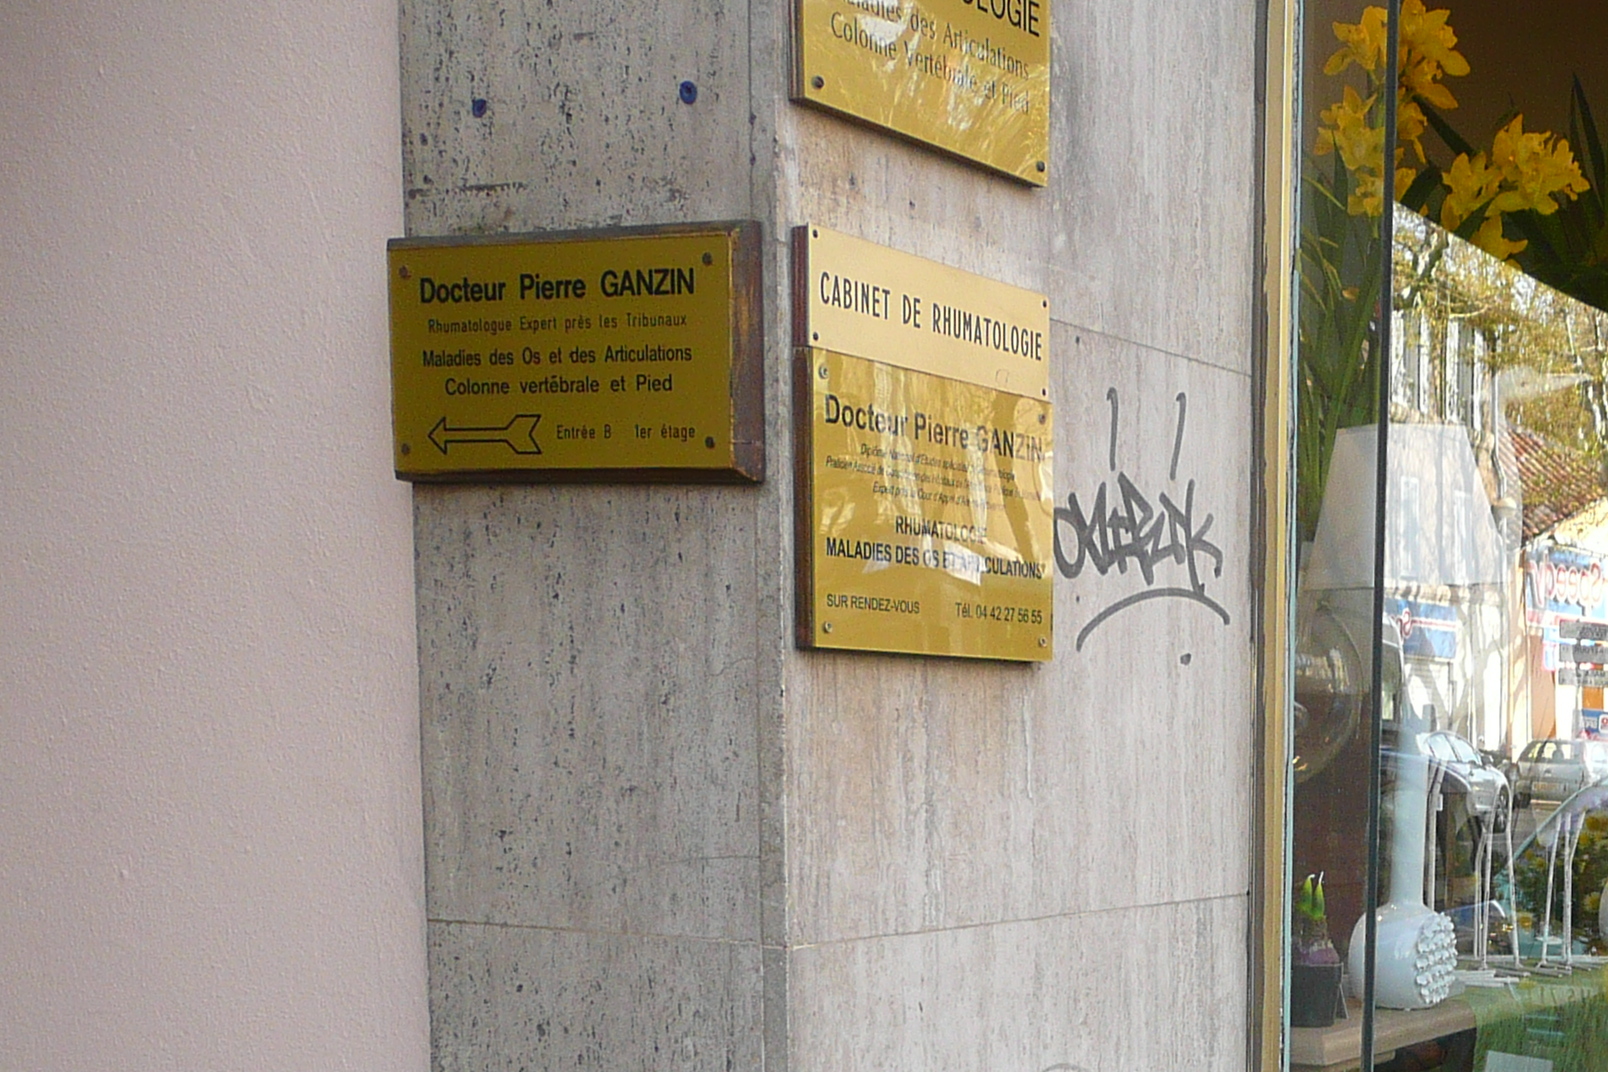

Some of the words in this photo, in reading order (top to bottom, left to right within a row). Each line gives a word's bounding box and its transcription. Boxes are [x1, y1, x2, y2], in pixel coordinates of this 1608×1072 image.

[910, 8, 936, 40] des
[943, 22, 1029, 81] Articulations
[831, 11, 897, 60] Colonne
[904, 40, 977, 92] Vertébrale
[984, 80, 996, 100] et
[1002, 82, 1029, 115] Pied
[420, 276, 506, 304] Docteur
[519, 273, 586, 300] Pierre
[600, 267, 695, 297] GANZIN
[428, 318, 512, 335] Rhumatologue
[519, 315, 557, 333] Expert
[565, 314, 592, 333] près
[599, 313, 618, 328] les
[626, 312, 687, 328] Tribunaux
[820, 271, 890, 320] CABINET
[902, 294, 921, 328] DE
[932, 302, 1042, 361] RHUMATOLOGIE
[422, 348, 482, 367] Maladies
[489, 348, 514, 366] des
[522, 347, 541, 364] Os
[549, 349, 562, 364] et
[570, 346, 596, 364] des
[604, 344, 692, 363] Articulations
[445, 377, 510, 396] Colonne
[519, 374, 600, 394] vertébrale
[610, 375, 627, 392] et
[636, 374, 673, 392] Pied
[556, 424, 596, 440] Entrée
[604, 425, 612, 440] B
[634, 424, 653, 440] 1er
[660, 424, 696, 442] étage
[824, 393, 908, 437] Docteur
[914, 412, 970, 449] Pierre
[977, 425, 1043, 463] GANZIN
[826, 537, 891, 562] MALADIES
[895, 546, 920, 569] DES
[923, 550, 939, 568] OS
[827, 593, 848, 608] SUR
[851, 595, 920, 614] RENDEZ-VOUS
[956, 602, 973, 619] Tél.
[976, 604, 988, 620] 04
[990, 605, 1002, 621] 42
[1004, 607, 1016, 622] 27
[1018, 609, 1029, 623] 56
[1031, 610, 1042, 625] 55
